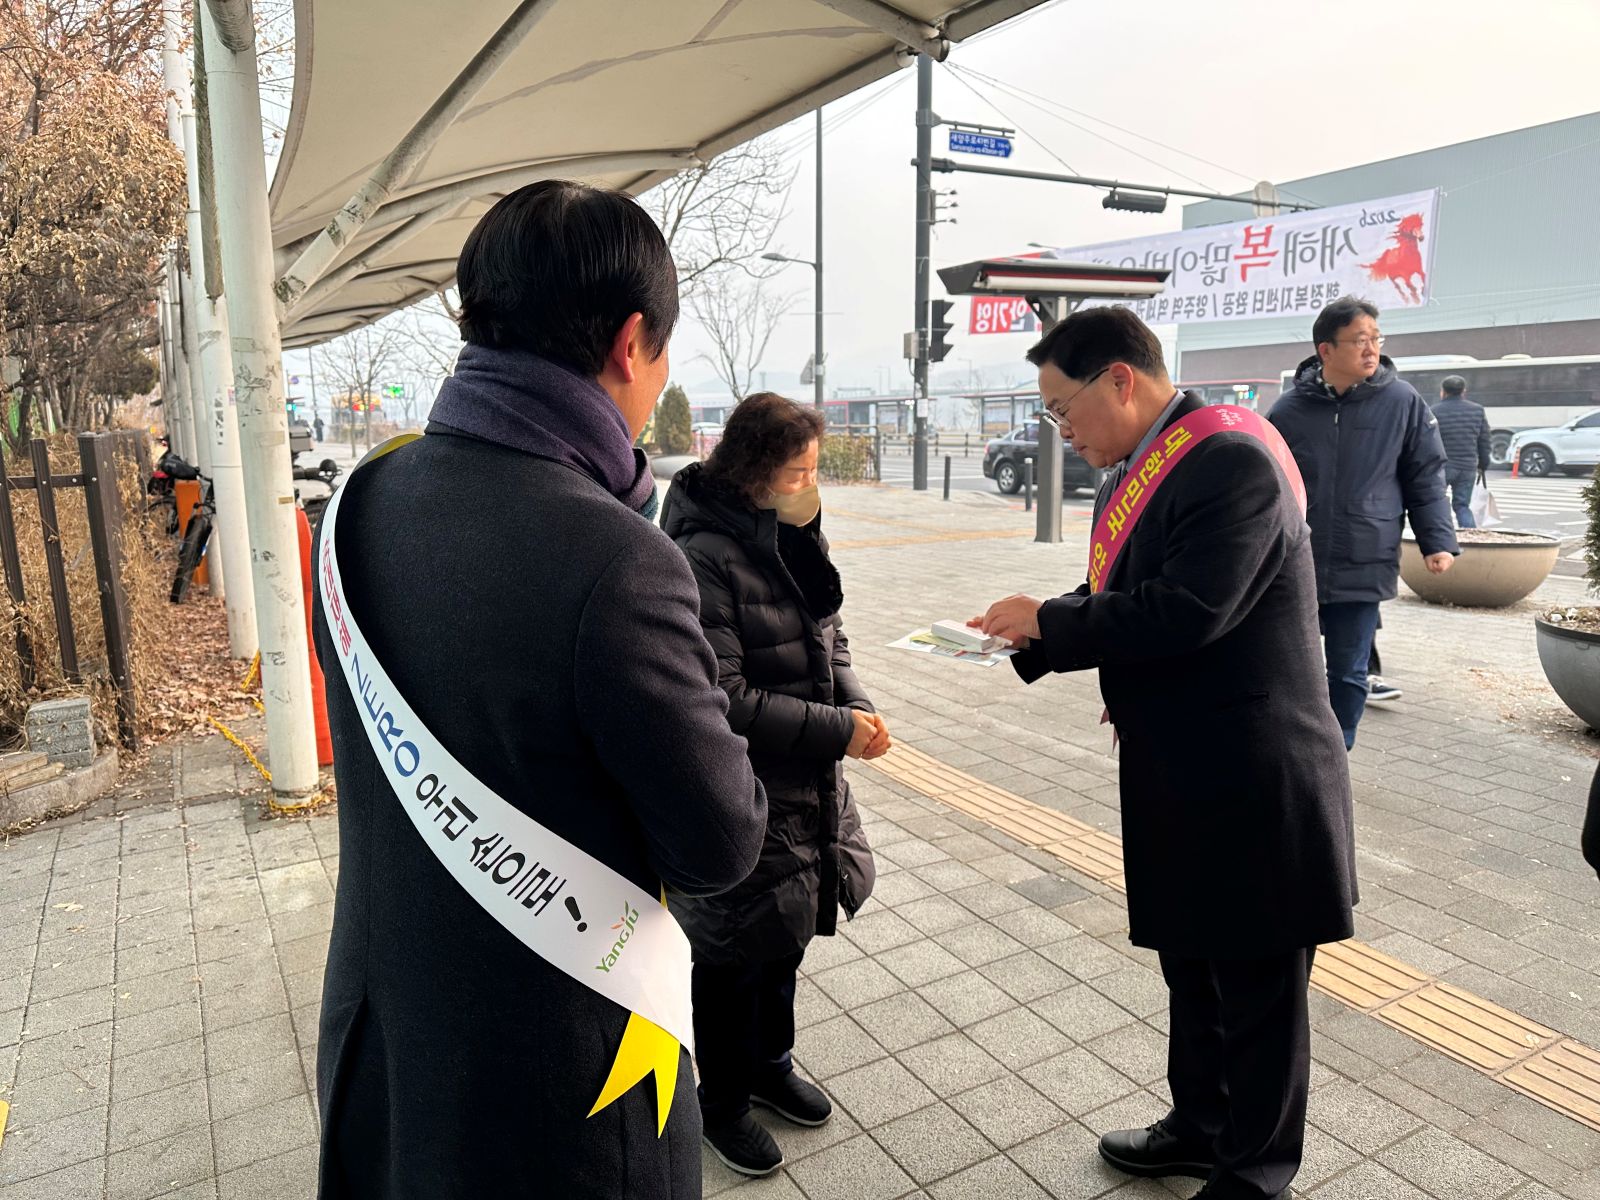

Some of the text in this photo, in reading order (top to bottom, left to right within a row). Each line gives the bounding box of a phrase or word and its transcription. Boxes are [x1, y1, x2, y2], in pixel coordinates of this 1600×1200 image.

[1107, 426, 1192, 541] 대한민국
[351, 652, 420, 778] ZERO
[415, 773, 479, 842] 우리
